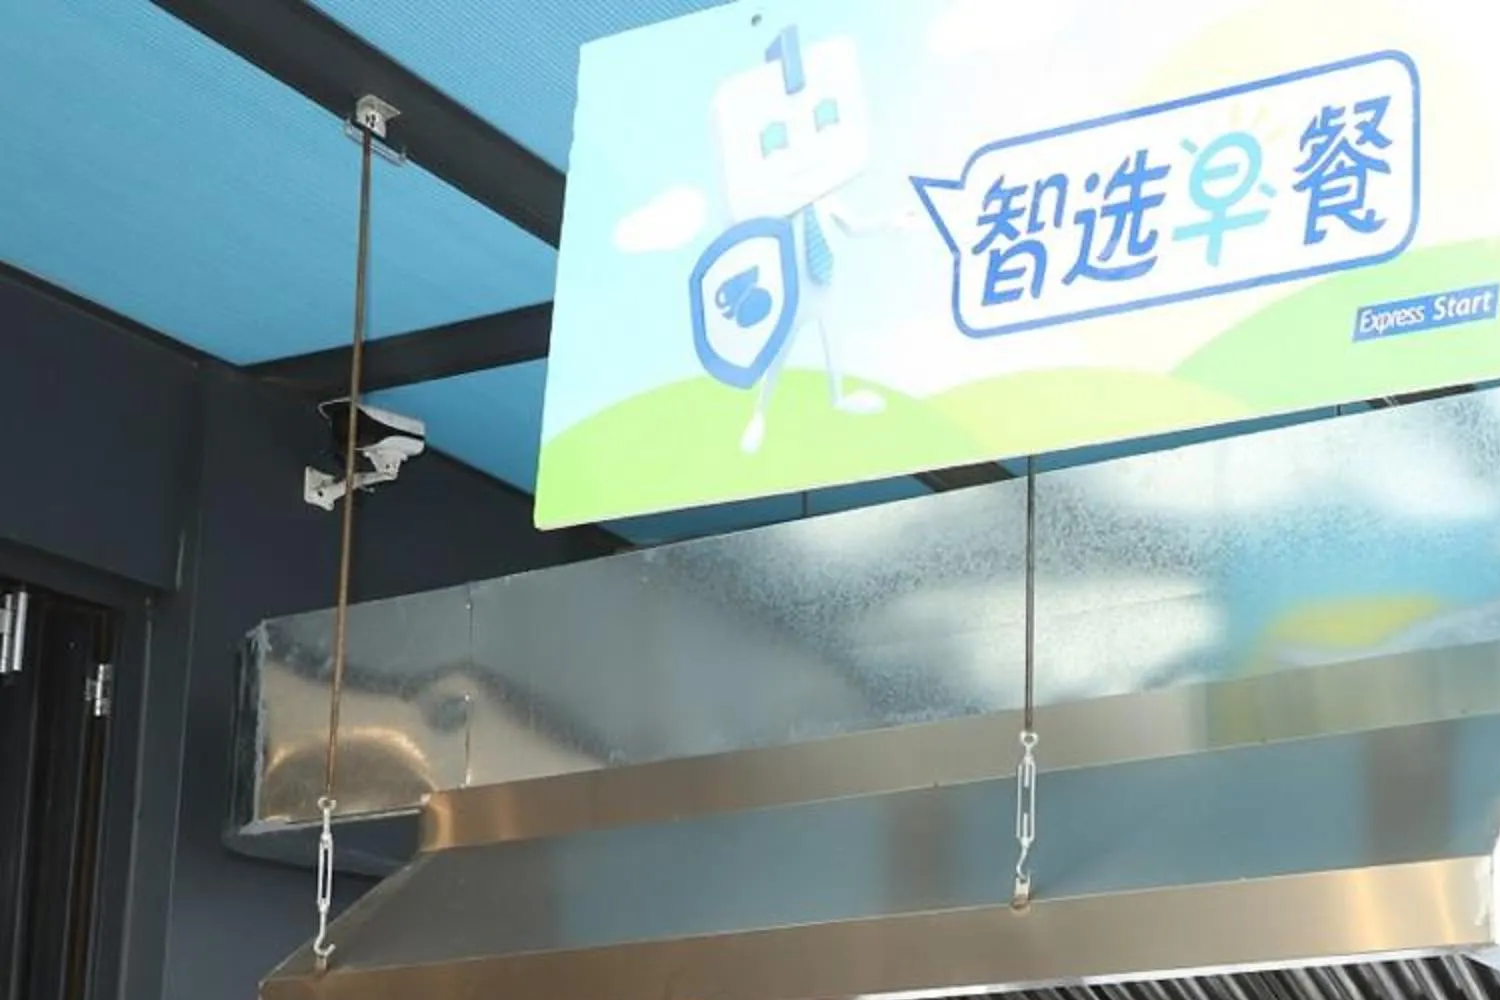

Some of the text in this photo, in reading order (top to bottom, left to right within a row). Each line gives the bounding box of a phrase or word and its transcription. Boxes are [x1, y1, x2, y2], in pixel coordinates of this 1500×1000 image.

[971, 94, 1393, 307] 智选早餐
[1359, 291, 1493, 334] Express Start
